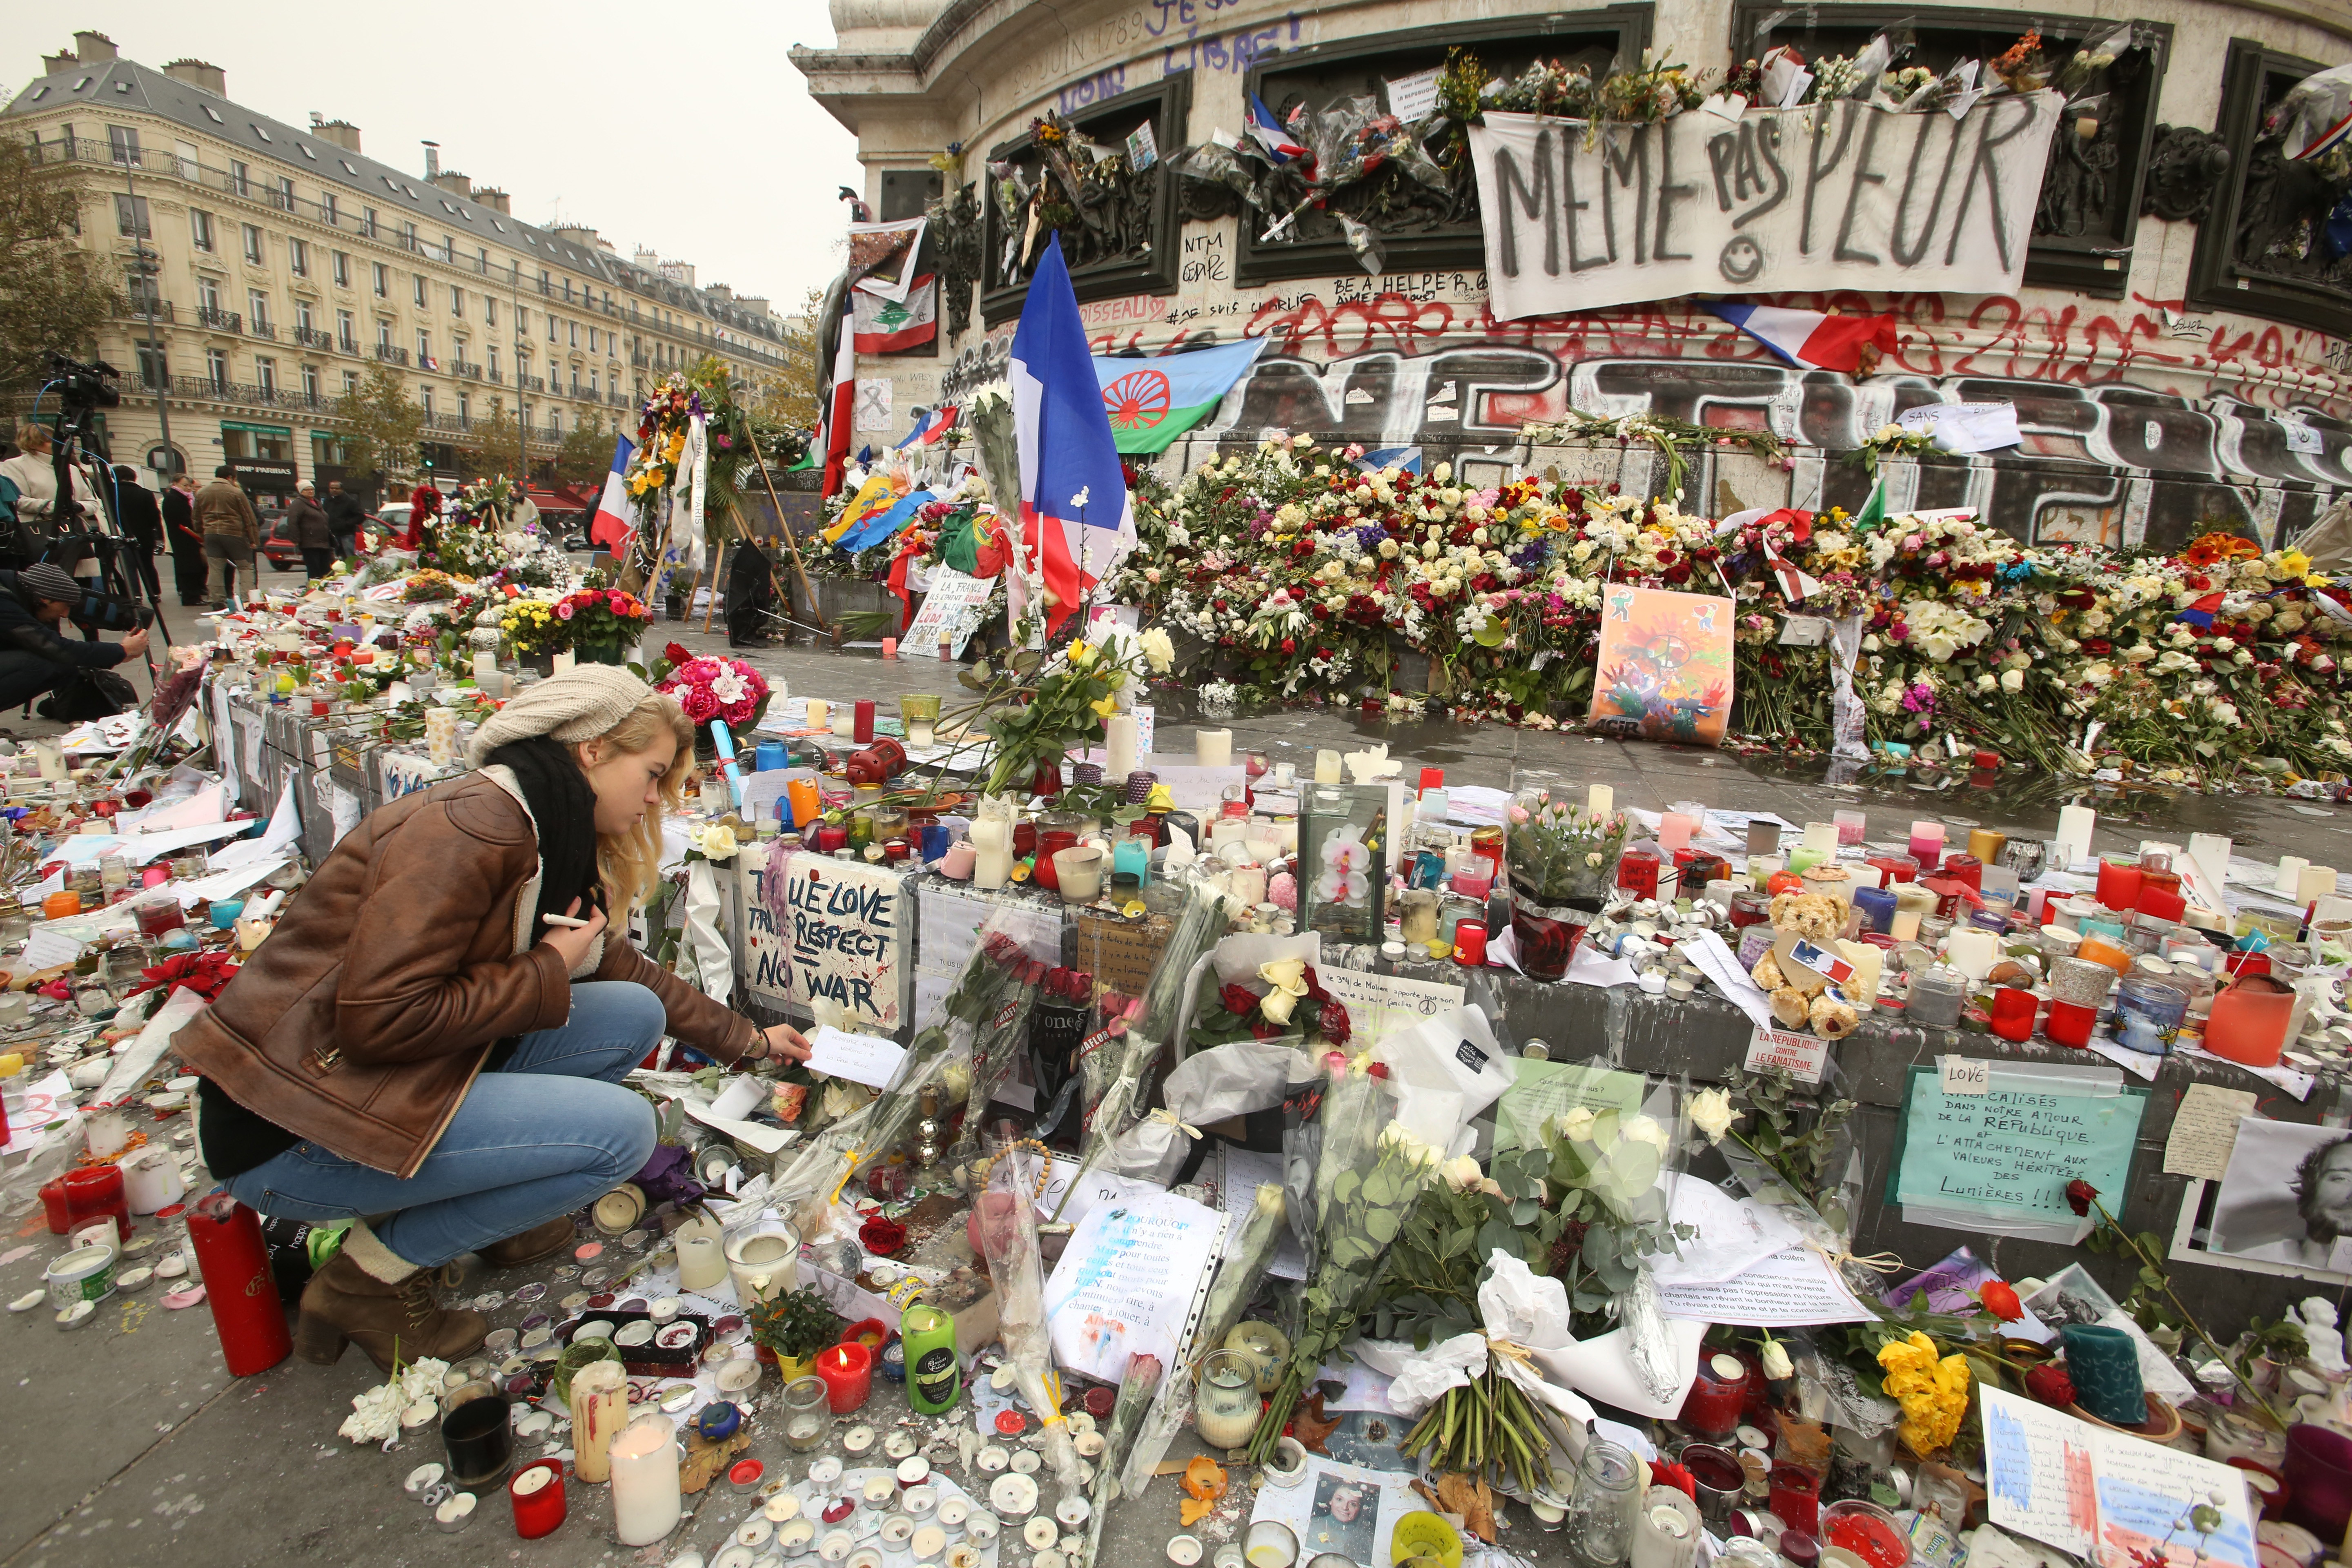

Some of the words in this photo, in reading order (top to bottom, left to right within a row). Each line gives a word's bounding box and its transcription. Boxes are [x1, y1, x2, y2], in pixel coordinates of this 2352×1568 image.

[1097, 12, 1142, 54] 1789
[1494, 122, 1694, 277] MEME
[1708, 116, 1790, 229] PAS
[1800, 95, 2037, 273] PEUR
[1334, 277, 1356, 294] BE
[1363, 278, 1372, 291] A
[1078, 295, 1147, 323] OISSEAU
[1908, 411, 1939, 423] SANS
[1387, 454, 1406, 463] PARIS
[256, 467, 292, 475] PARIBAS
[940, 582, 950, 592] LA
[956, 583, 984, 592] FRANCE
[917, 613, 942, 623] LUDO
[909, 626, 939, 636] MORTS
[903, 635, 915, 644] LES
[749, 870, 829, 914] TUE
[827, 881, 893, 927] LOVE
[796, 911, 890, 962] RESPECT
[1125, 938, 1133, 946] de
[1125, 965, 1149, 977] l'offense
[757, 951, 793, 989] NO
[804, 969, 881, 1018] WAR
[1353, 979, 1361, 987] de
[1394, 990, 1420, 999] apporte
[1386, 998, 1412, 1009] familles
[1045, 1014, 1074, 1028] one
[1760, 1032, 1769, 1042] LA
[1771, 1033, 1821, 1051] RÉPUBLIQUE
[1460, 1048, 1475, 1060] MONCEAU
[1775, 1047, 1798, 1057] CONTRE
[1755, 1052, 1766, 1062] LE
[1767, 1054, 1812, 1070] FANATISME
[1949, 1066, 1983, 1082] LOVE
[1938, 1113, 1952, 1122] DE
[1958, 1114, 1971, 1123] LA
[1945, 1101, 1976, 1111] DANS
[1984, 1105, 2022, 1118] NOTRE
[2031, 1111, 2083, 1125] AMOUR
[2064, 1155, 2088, 1166] AUX
[1993, 1171, 2020, 1180] DES
[267, 1217, 280, 1231] happy
[289, 1224, 310, 1249] happy
[1157, 1229, 1174, 1238] rien
[1177, 1232, 1183, 1240] à
[1109, 1236, 1164, 1250] comprendre.
[1119, 1250, 1142, 1260] pour
[1143, 1253, 1170, 1263] toutes
[1780, 1254, 1805, 1262] colère
[1087, 1256, 1113, 1266] celles
[1116, 1260, 1125, 1268] et
[1127, 1262, 1145, 1272] tous
[1148, 1266, 1169, 1274] ceux
[1146, 1278, 1168, 1288] pour
[1743, 1272, 1790, 1281] conscience
[1792, 1276, 1826, 1285] sensible
[1723, 1287, 1739, 1295] pas
[1741, 1288, 1792, 1299] l'oppression
[1803, 1294, 1832, 1302] l'injure
[1795, 1284, 1826, 1293] inventé
[1126, 1296, 1146, 1310] rire,
[1148, 1302, 1154, 1312] à
[1665, 1290, 1700, 1300] chantais
[1755, 1297, 1791, 1306] bonheur
[1682, 1300, 1708, 1308] rêvais
[1711, 1301, 1735, 1310] d'être
[1113, 1308, 1142, 1325] jouer,
[1144, 1316, 1150, 1326] à
[929, 1357, 947, 1366] BOUGIES
[931, 1363, 945, 1372] FRANCE
